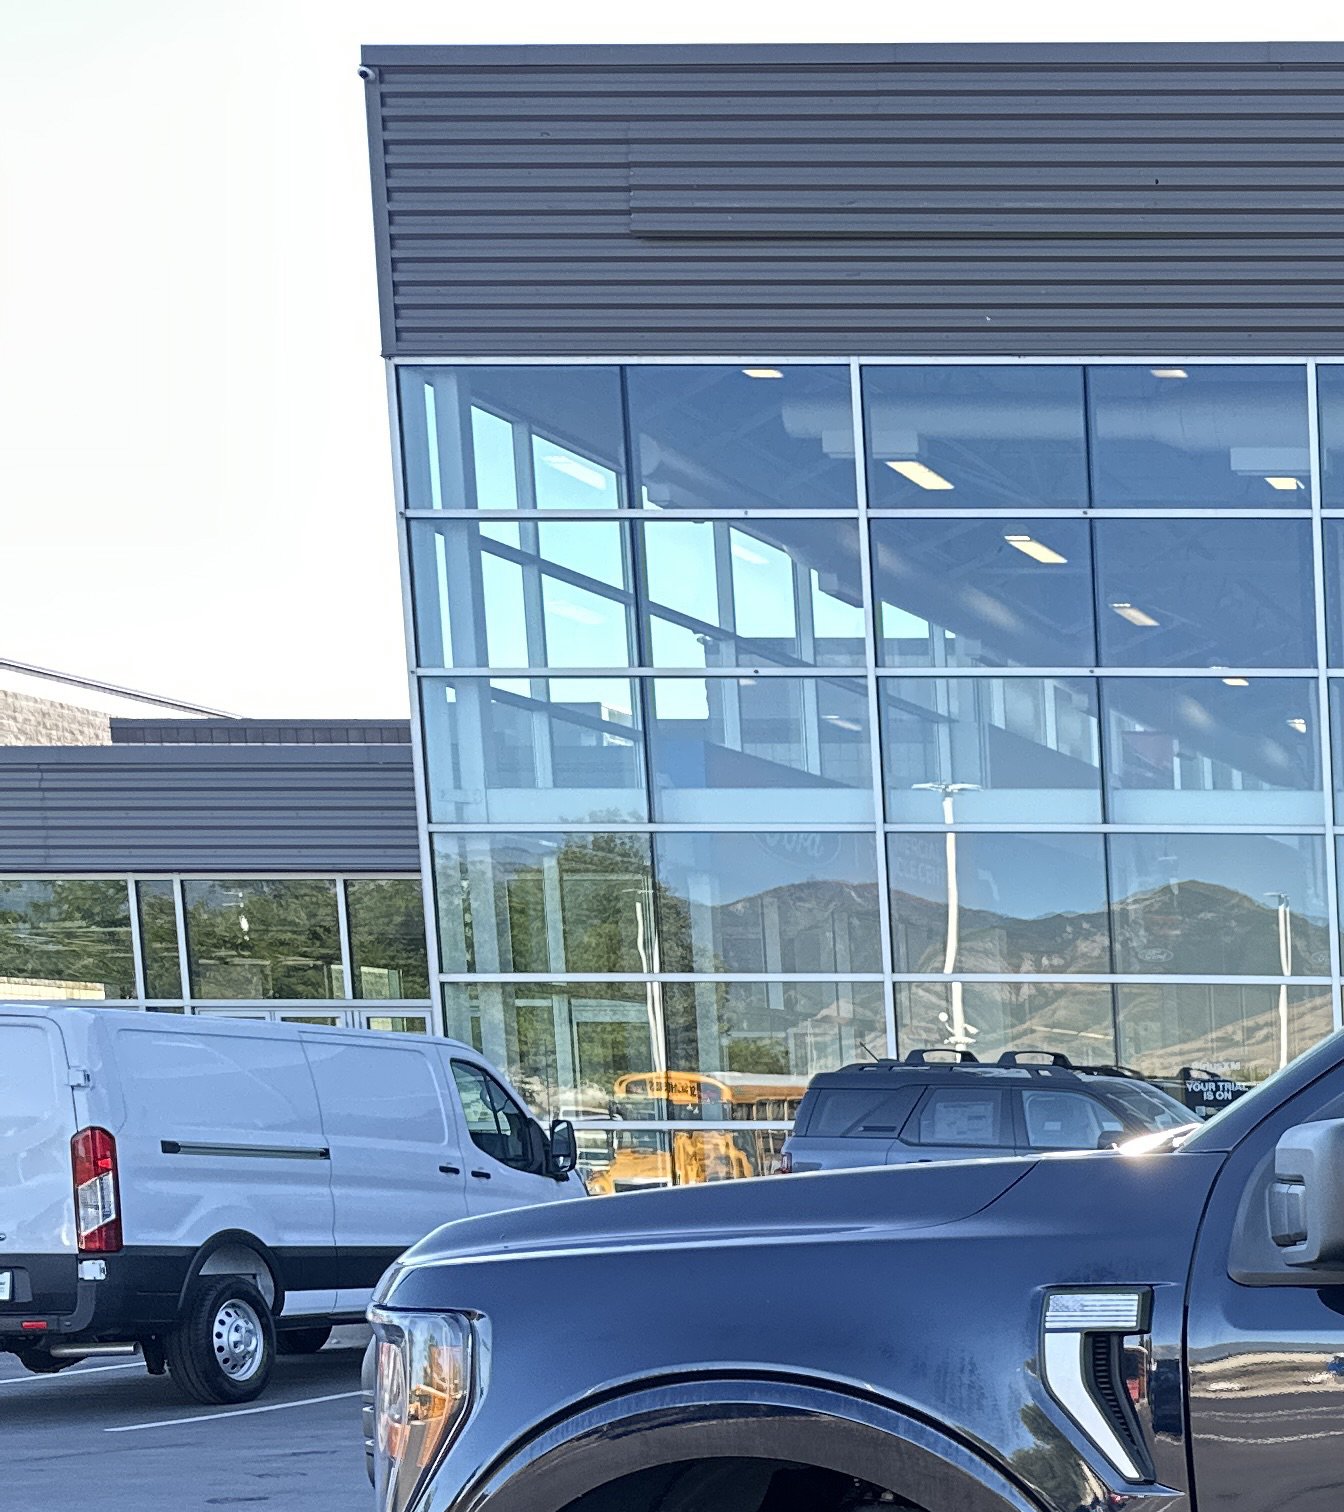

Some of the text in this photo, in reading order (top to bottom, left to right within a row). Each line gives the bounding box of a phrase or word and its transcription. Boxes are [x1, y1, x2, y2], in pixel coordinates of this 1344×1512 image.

[1186, 1081, 1249, 1092] YOUR TRIAL
[1203, 1091, 1233, 1101] IS ON
